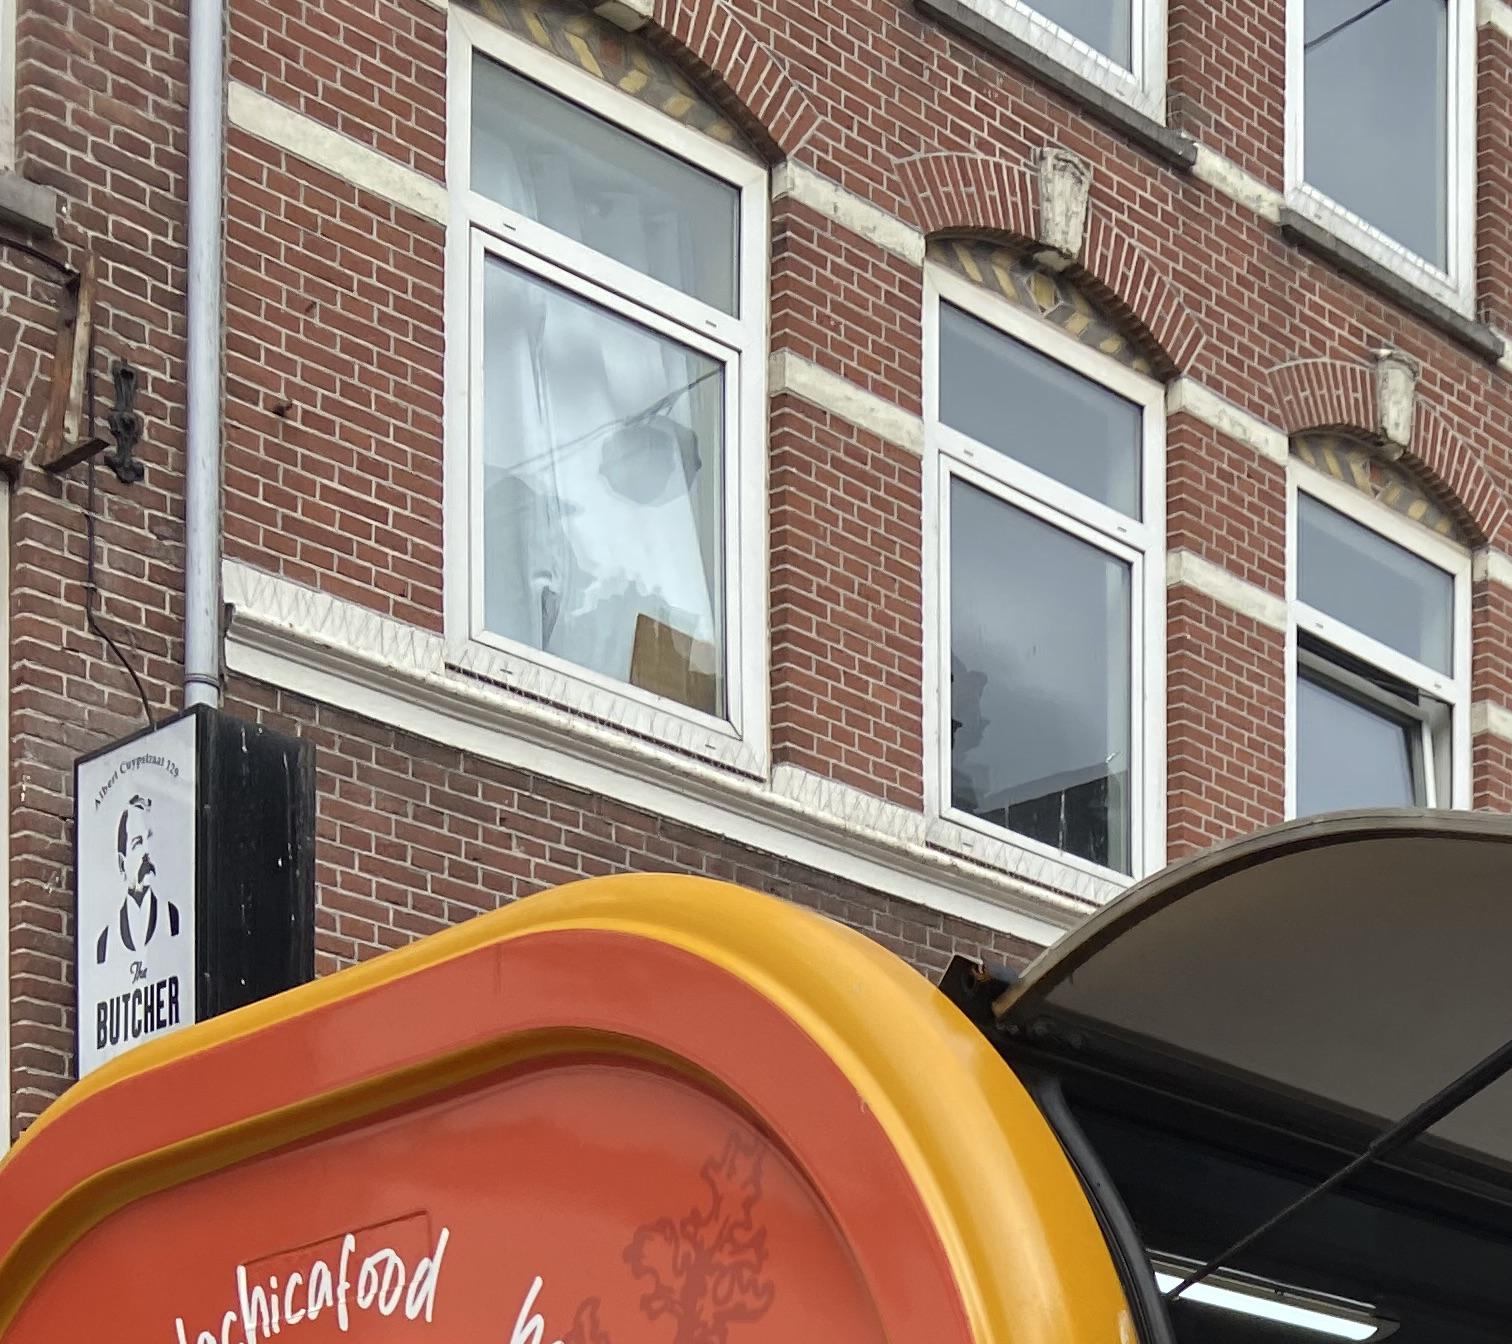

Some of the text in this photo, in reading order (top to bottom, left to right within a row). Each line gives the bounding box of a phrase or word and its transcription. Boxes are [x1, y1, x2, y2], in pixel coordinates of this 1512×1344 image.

[165, 759, 180, 778] 129
[129, 961, 148, 984] The
[96, 975, 180, 1050] BUTCHER
